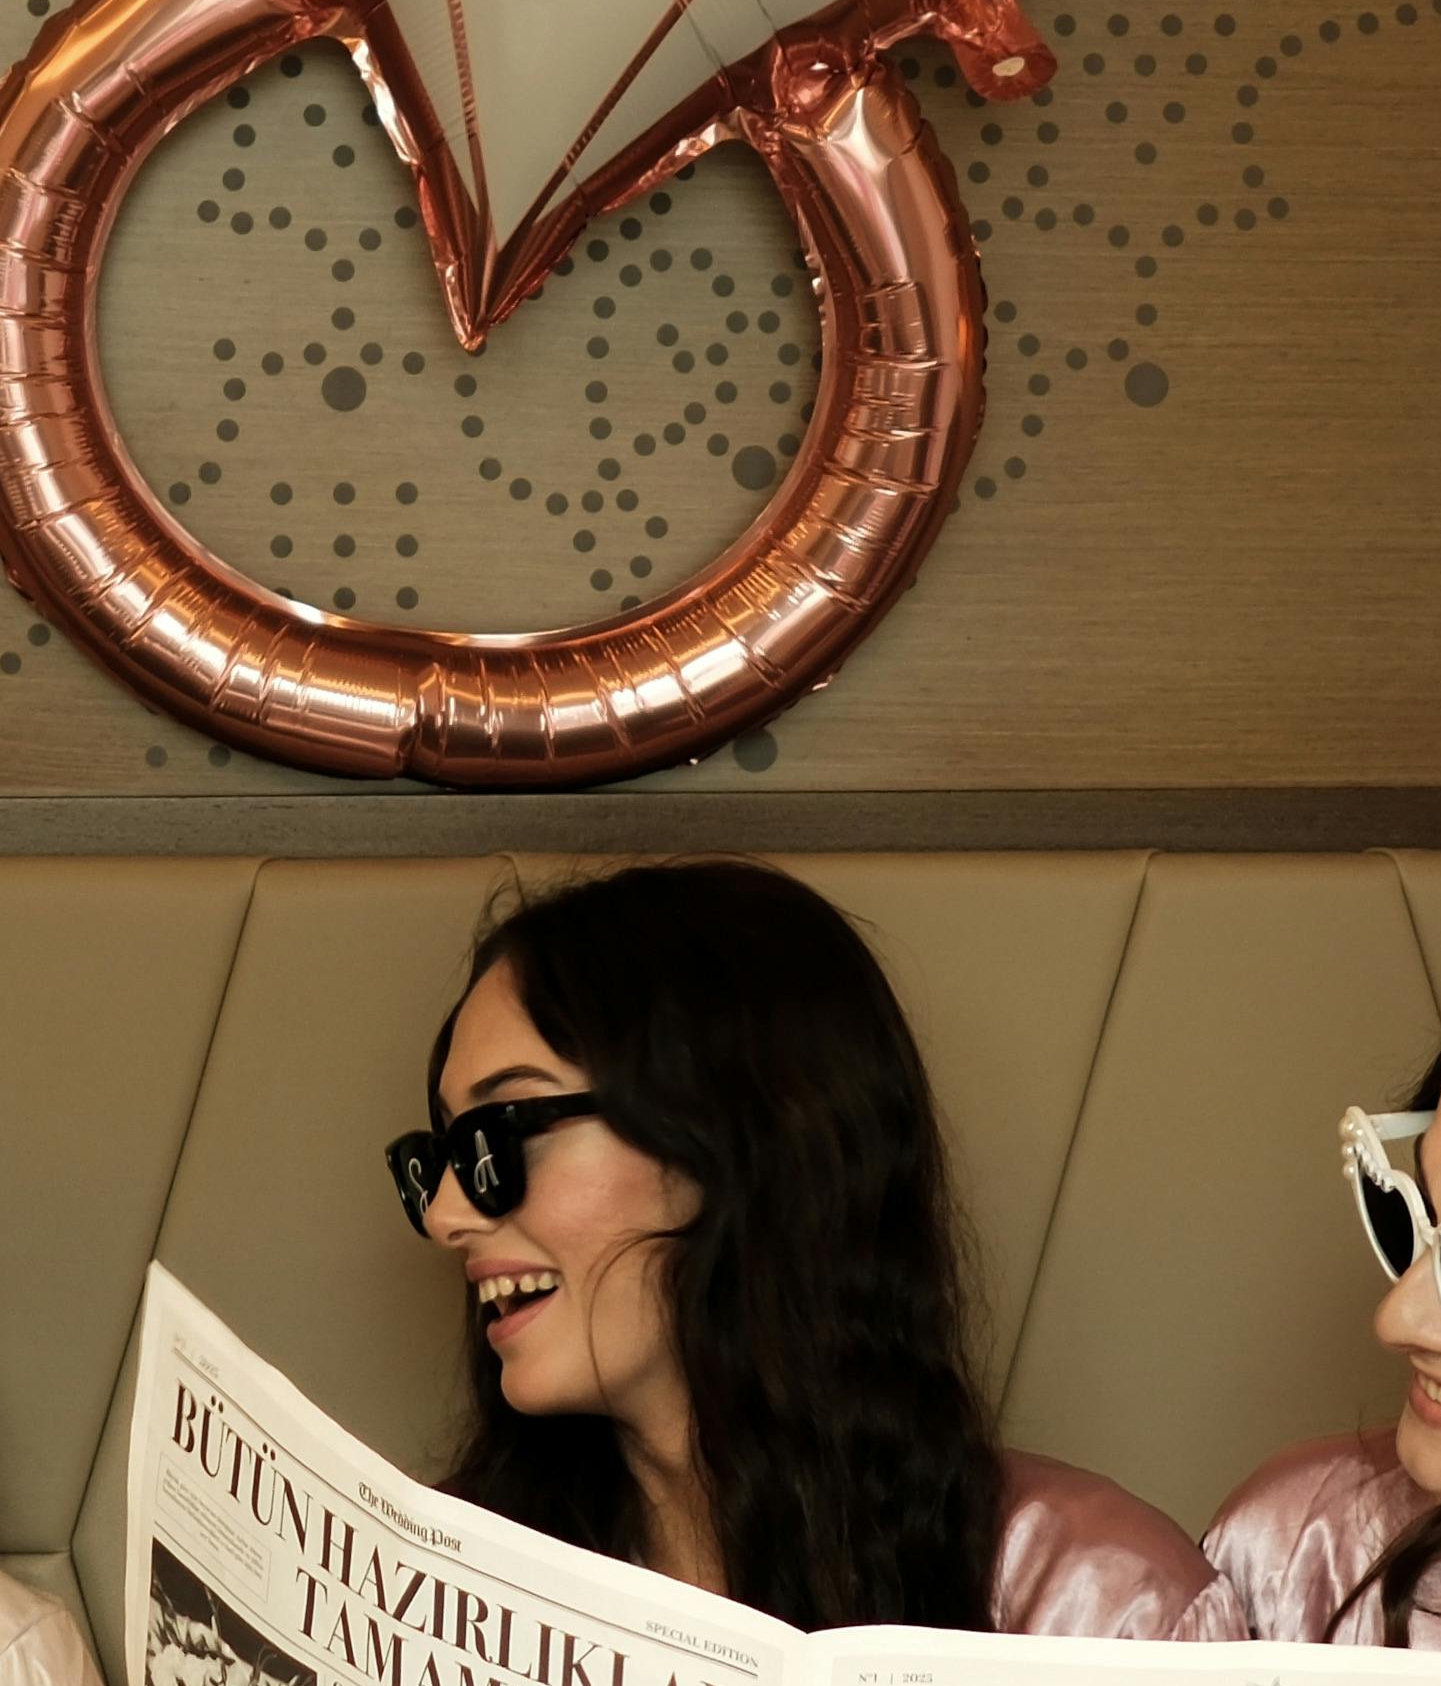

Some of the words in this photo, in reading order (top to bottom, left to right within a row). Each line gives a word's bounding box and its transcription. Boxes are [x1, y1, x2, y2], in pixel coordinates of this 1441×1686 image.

[171, 1377, 314, 1555] BÜTÜN
[358, 1481, 381, 1507] The
[379, 1492, 429, 1543] Wedding
[428, 1525, 462, 1553] Post
[645, 1619, 701, 1650] SPECIAL
[703, 1639, 759, 1668] EDITION
